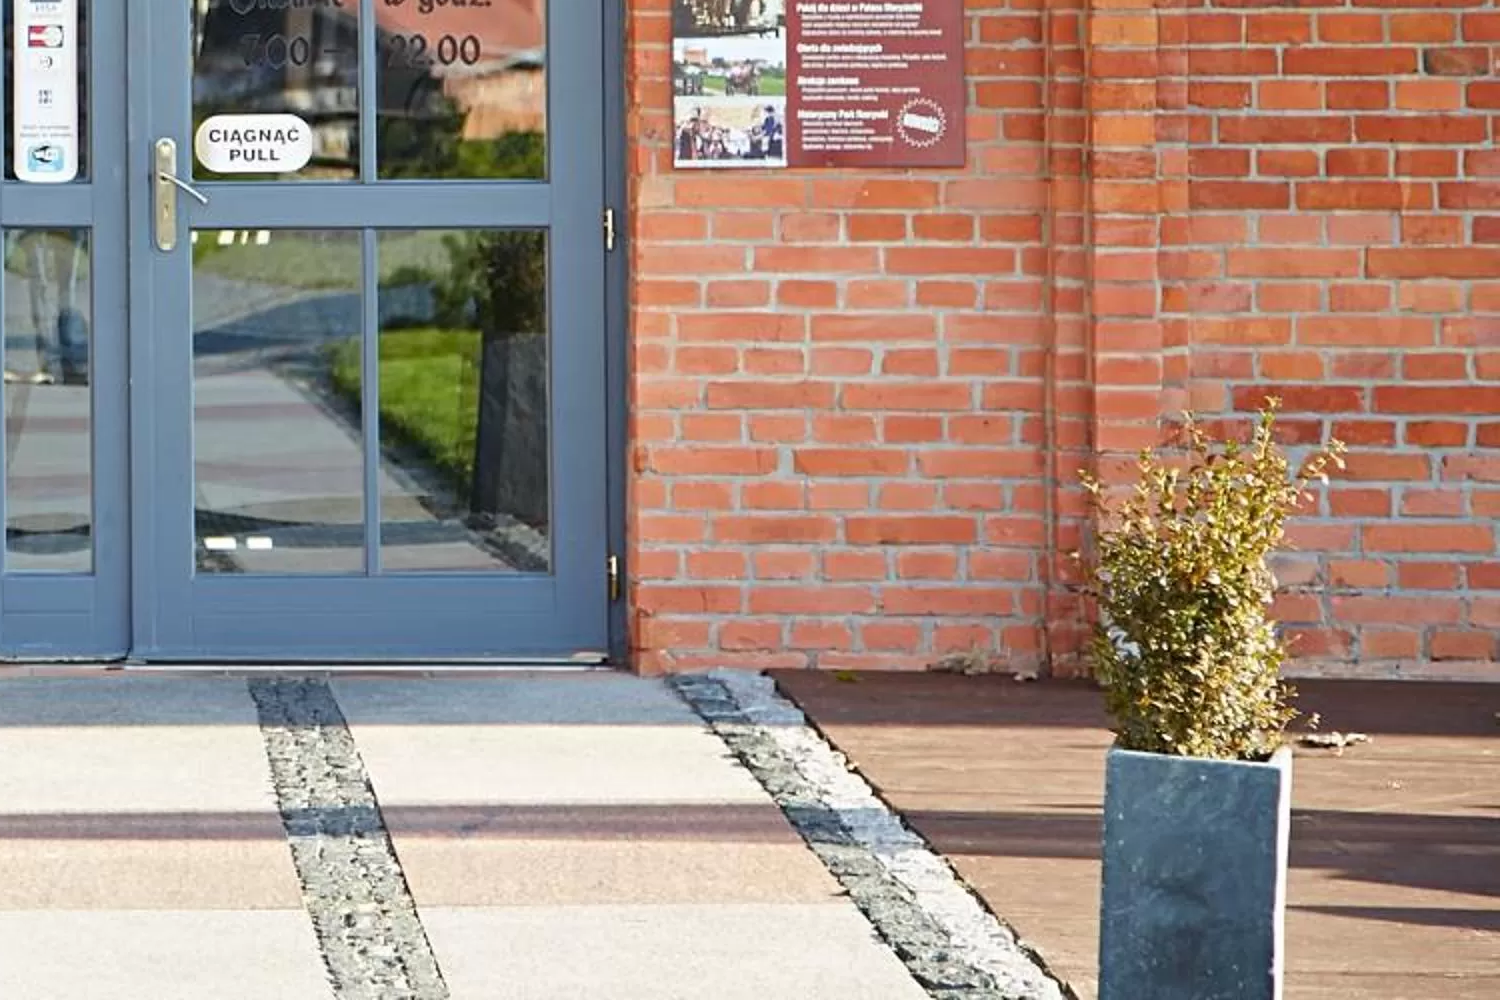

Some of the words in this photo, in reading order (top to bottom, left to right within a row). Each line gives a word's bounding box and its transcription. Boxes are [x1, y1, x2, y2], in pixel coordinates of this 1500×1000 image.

[387, 33, 481, 67] 22.00
[209, 125, 300, 146] CIĄGNĄĆ
[229, 148, 281, 162] PULL
